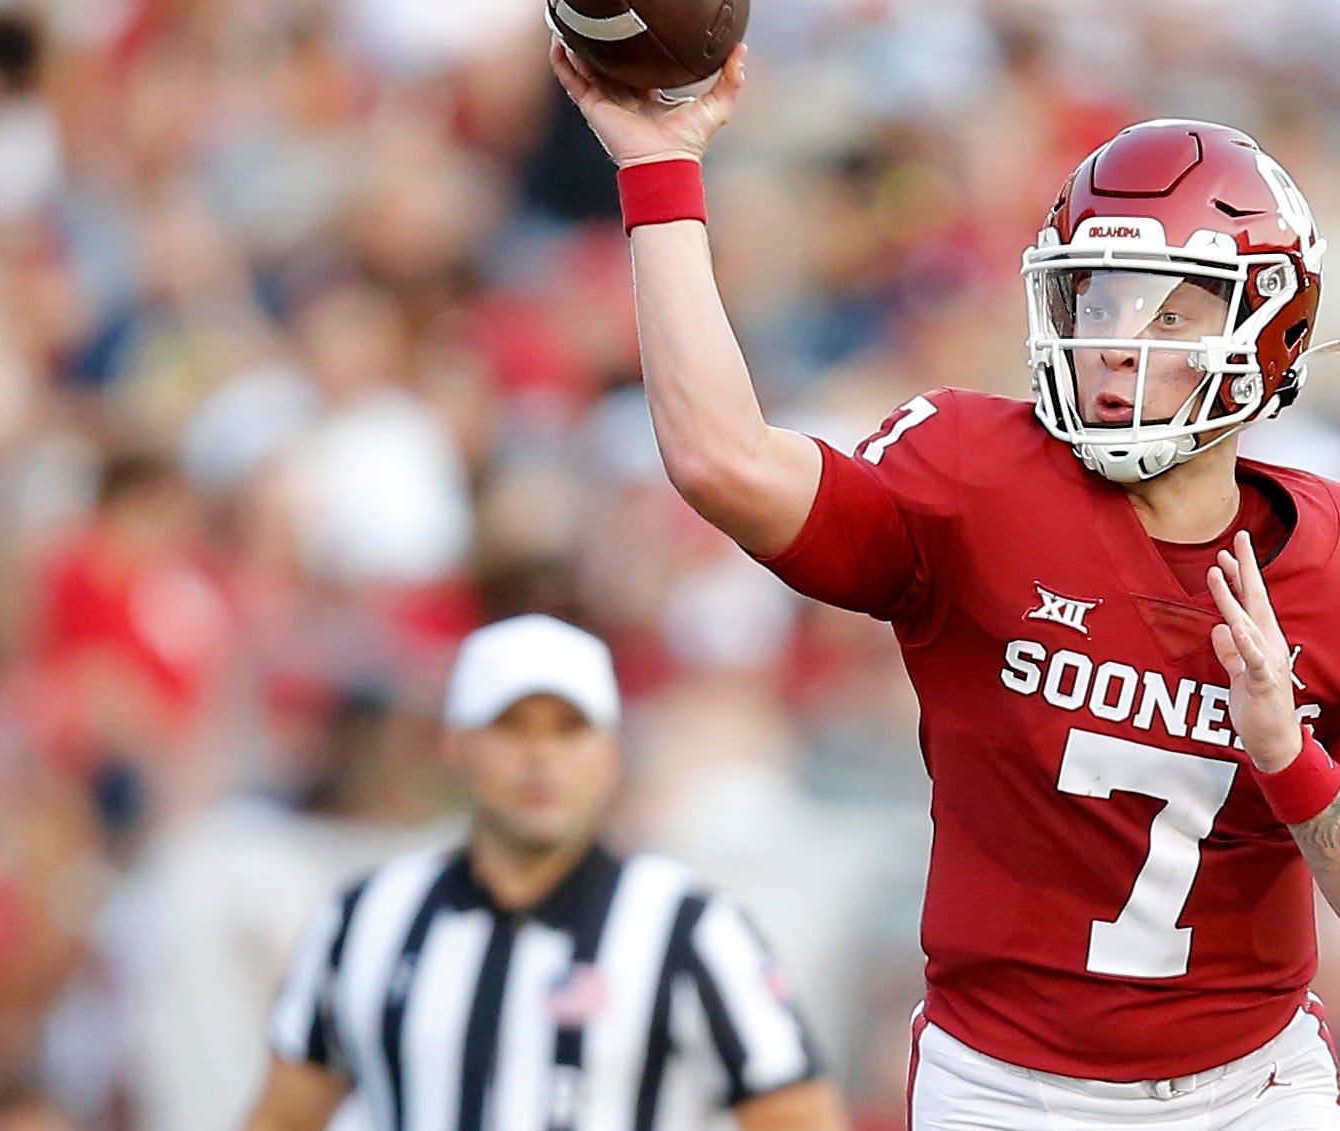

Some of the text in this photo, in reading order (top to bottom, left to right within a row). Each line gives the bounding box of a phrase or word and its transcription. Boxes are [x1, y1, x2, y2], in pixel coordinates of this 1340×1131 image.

[1088, 226, 1141, 239] OKLAHOMA
[860, 394, 939, 466] 7
[1026, 585, 1097, 635] XII
[1000, 639, 1322, 751] SOONE
[1057, 727, 1239, 979] 7
